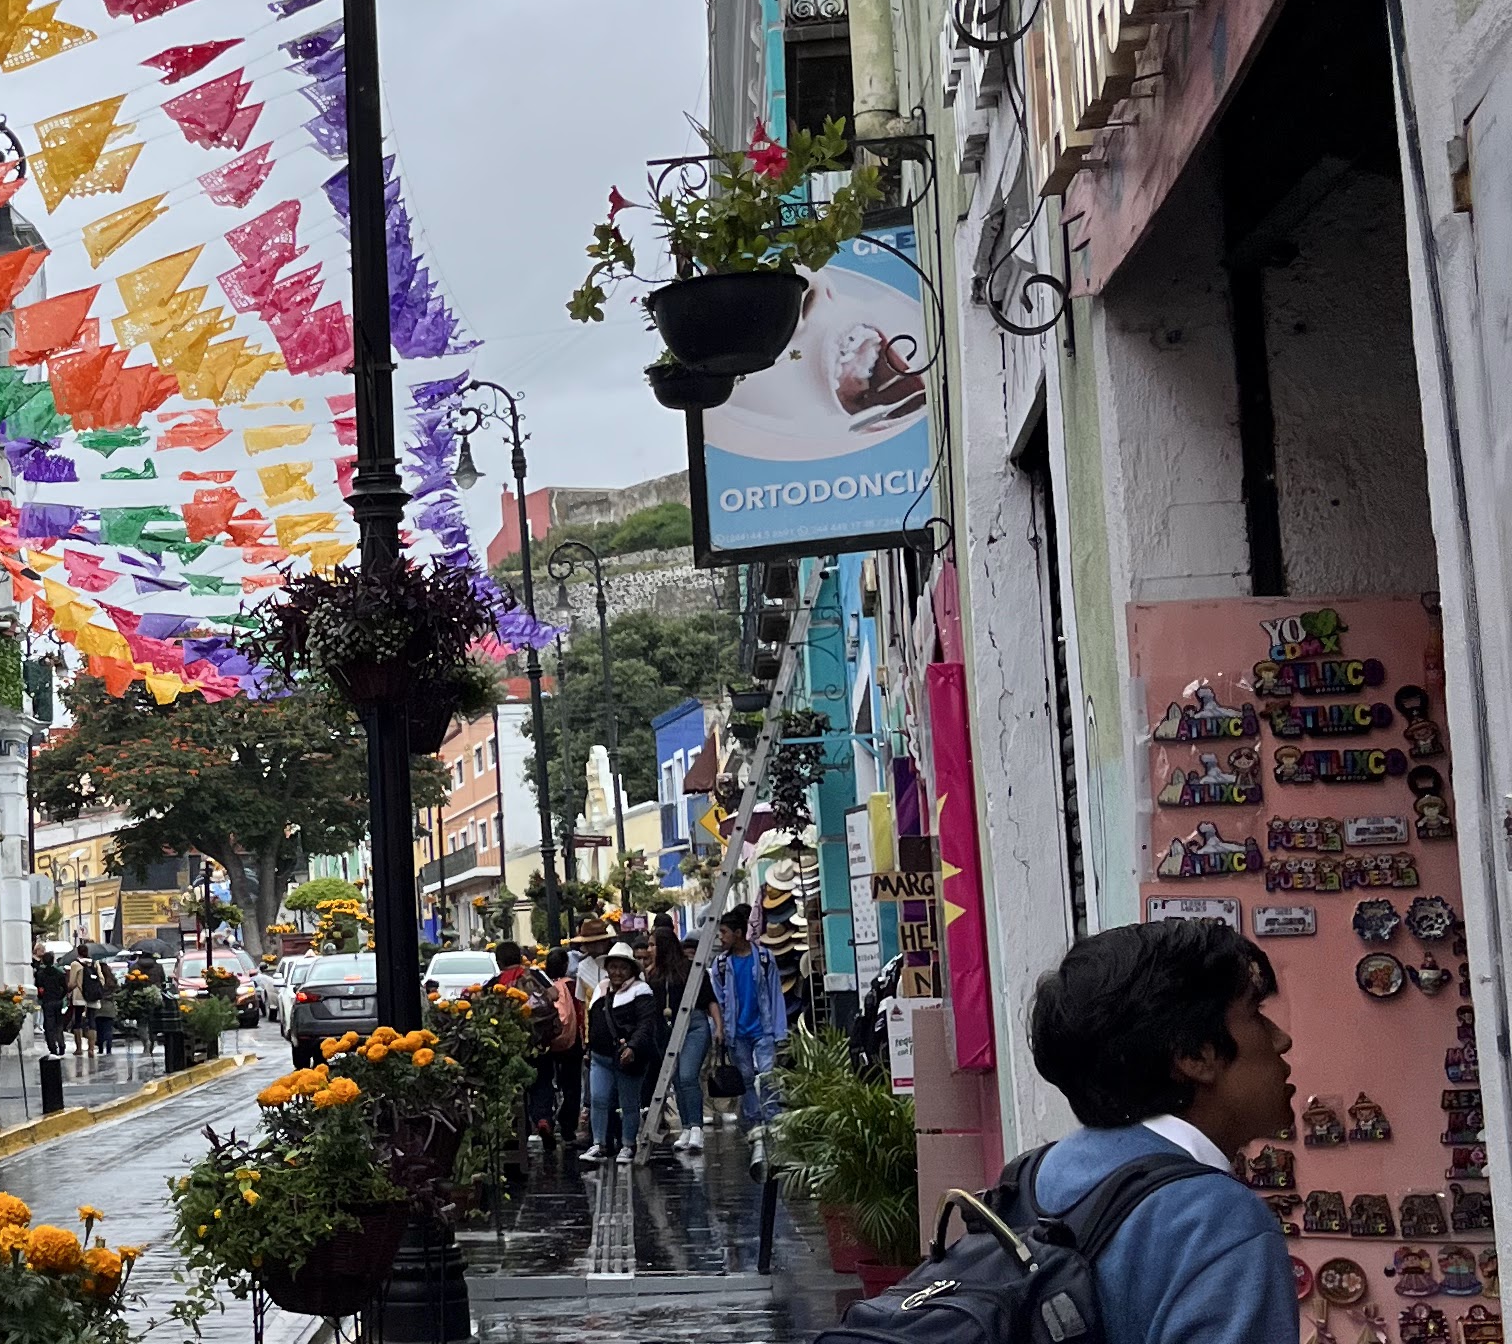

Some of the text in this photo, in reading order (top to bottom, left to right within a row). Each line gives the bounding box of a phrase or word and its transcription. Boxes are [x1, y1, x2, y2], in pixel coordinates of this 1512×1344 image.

[718, 467, 936, 514] ORTODONCIA
[1262, 617, 1306, 646] YO
[1281, 660, 1385, 687] ATLIXCO
[1178, 715, 1259, 739] ATLIXCO
[1291, 703, 1393, 729] ATLIXCO
[1300, 749, 1408, 777] ATLIXCO
[1180, 782, 1263, 805] ATLIXCO
[1180, 852, 1263, 876] ATLIXCO
